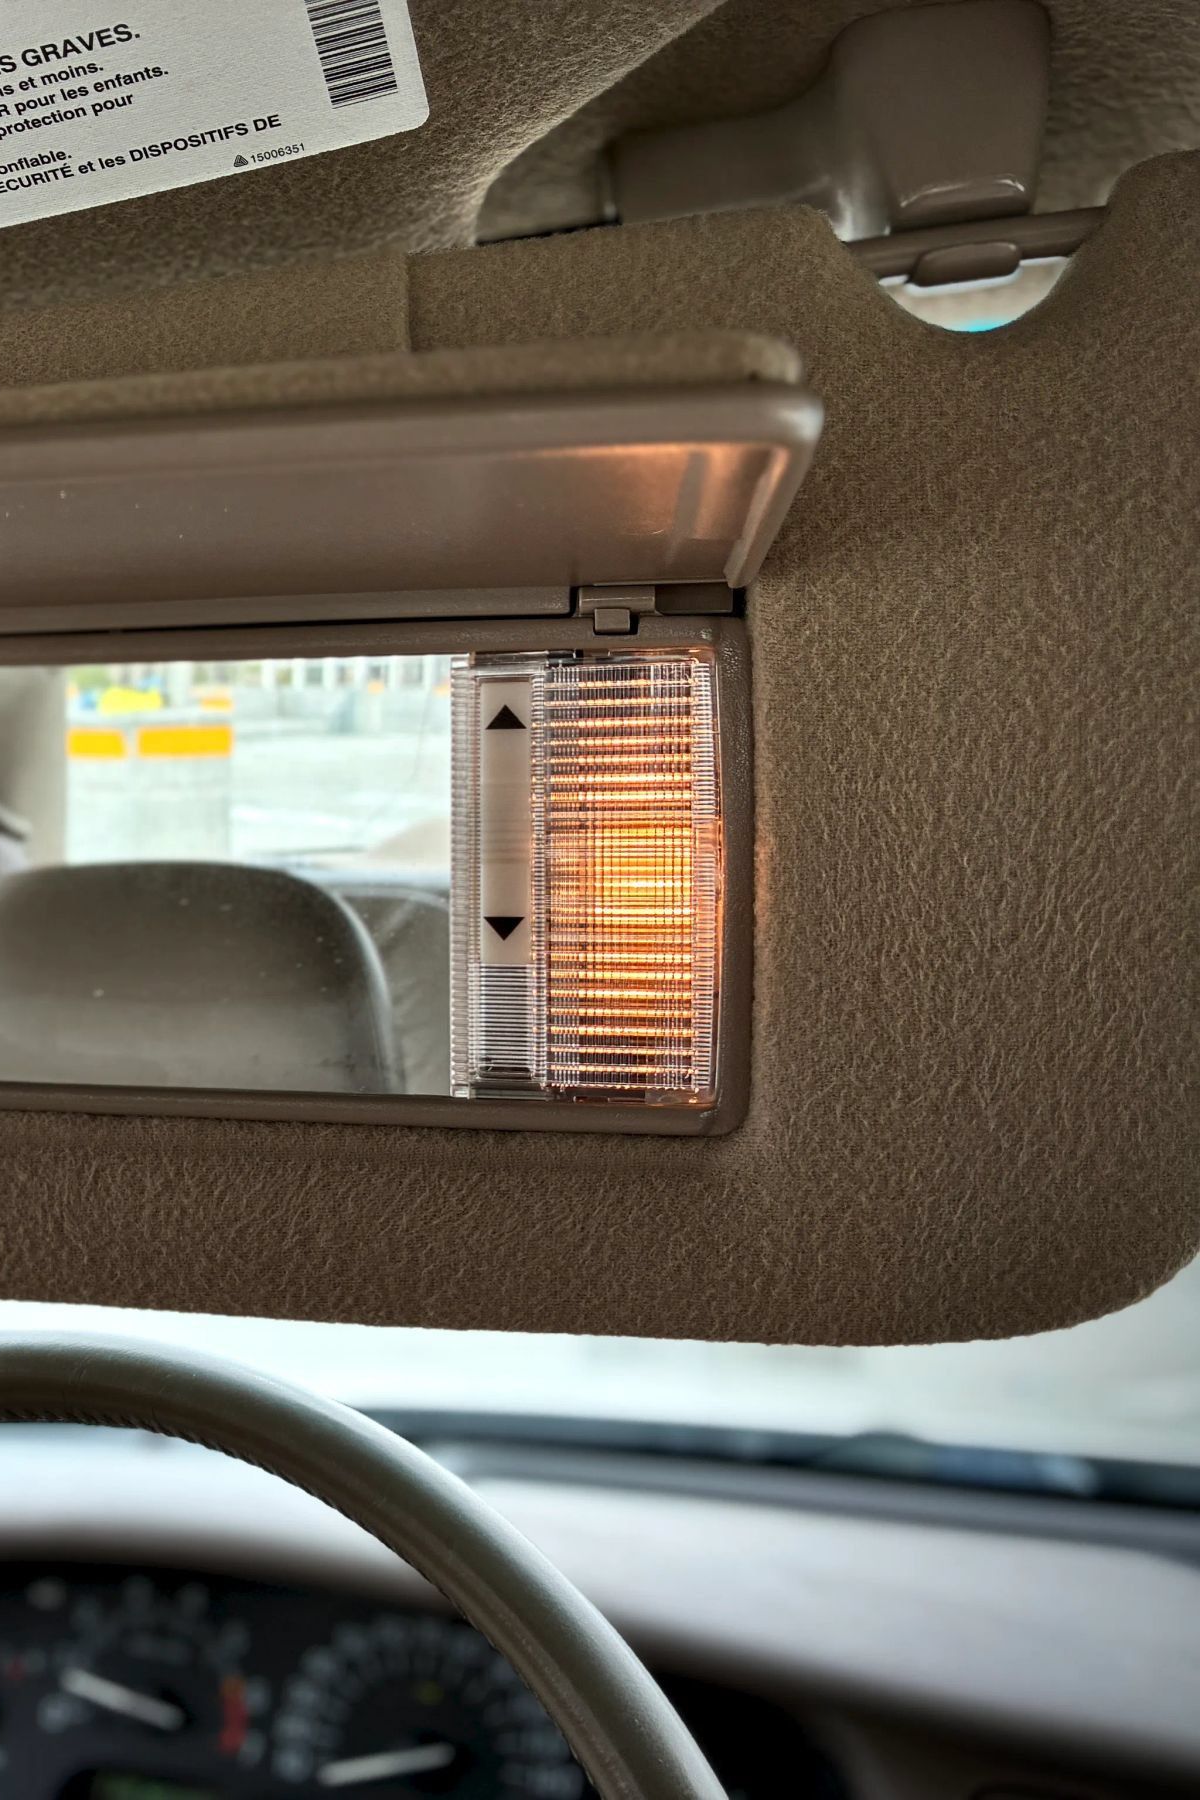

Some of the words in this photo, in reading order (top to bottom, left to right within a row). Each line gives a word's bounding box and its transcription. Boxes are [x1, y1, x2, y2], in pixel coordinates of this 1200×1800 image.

[21, 23, 140, 66] GRAVES.
[13, 93, 55, 115] pour
[59, 86, 89, 101] les
[93, 66, 168, 92] enfants.
[18, 76, 38, 91] et
[40, 62, 104, 85] moins.
[90, 93, 133, 116] pour
[77, 160, 96, 174] et
[97, 155, 126, 169] les
[128, 122, 248, 162] DISPOSITIFS
[252, 114, 281, 132] DE
[250, 142, 304, 162] 15006351
